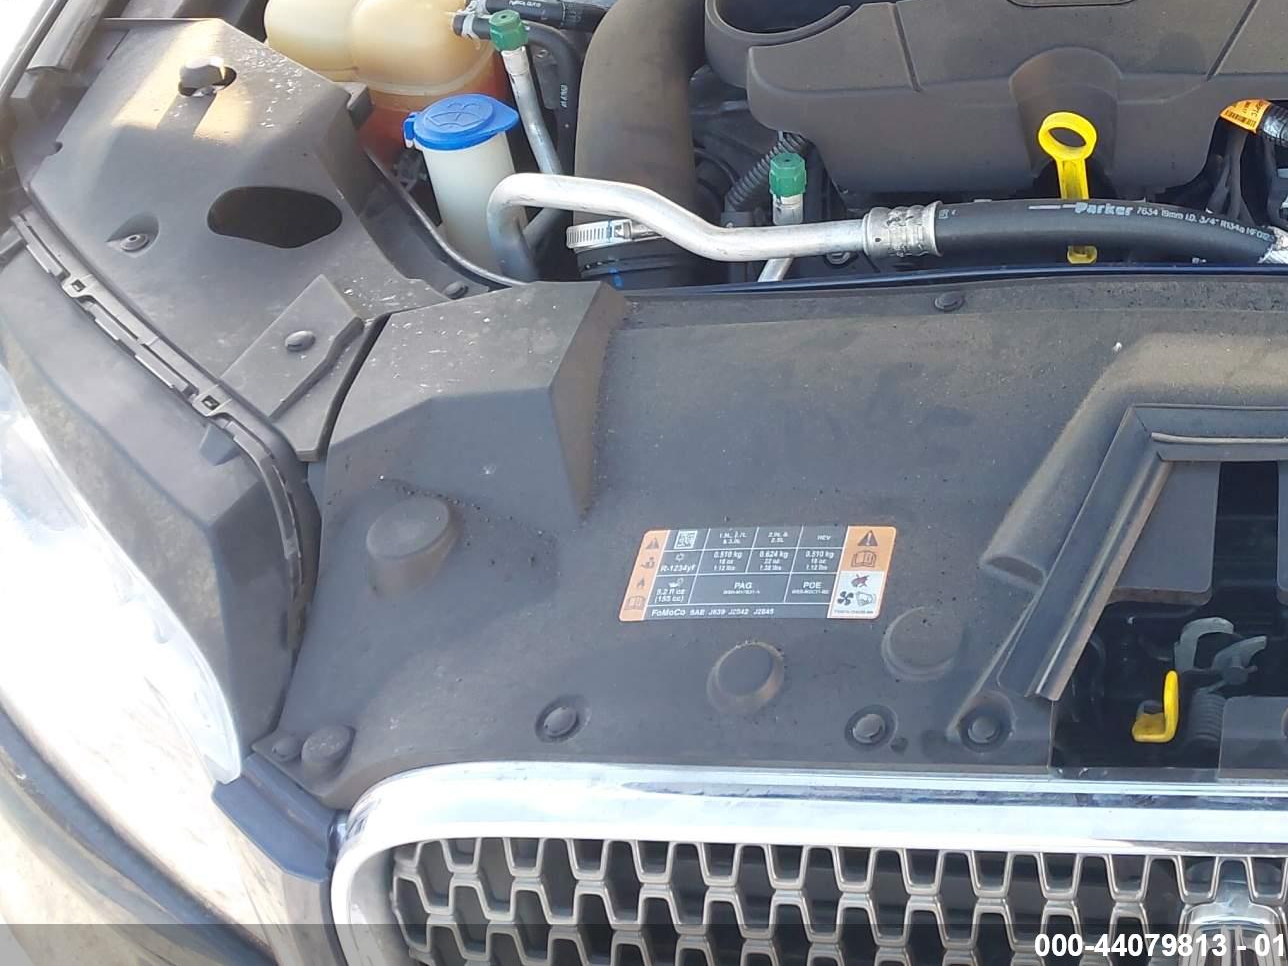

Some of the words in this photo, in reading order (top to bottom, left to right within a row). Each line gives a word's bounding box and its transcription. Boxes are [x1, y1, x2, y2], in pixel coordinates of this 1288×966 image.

[1074, 201, 1134, 217] Parker
[660, 563, 697, 574] R-1234yf
[734, 581, 753, 590] PAG
[803, 581, 822, 590] POE
[651, 607, 686, 617] FoMoCo
